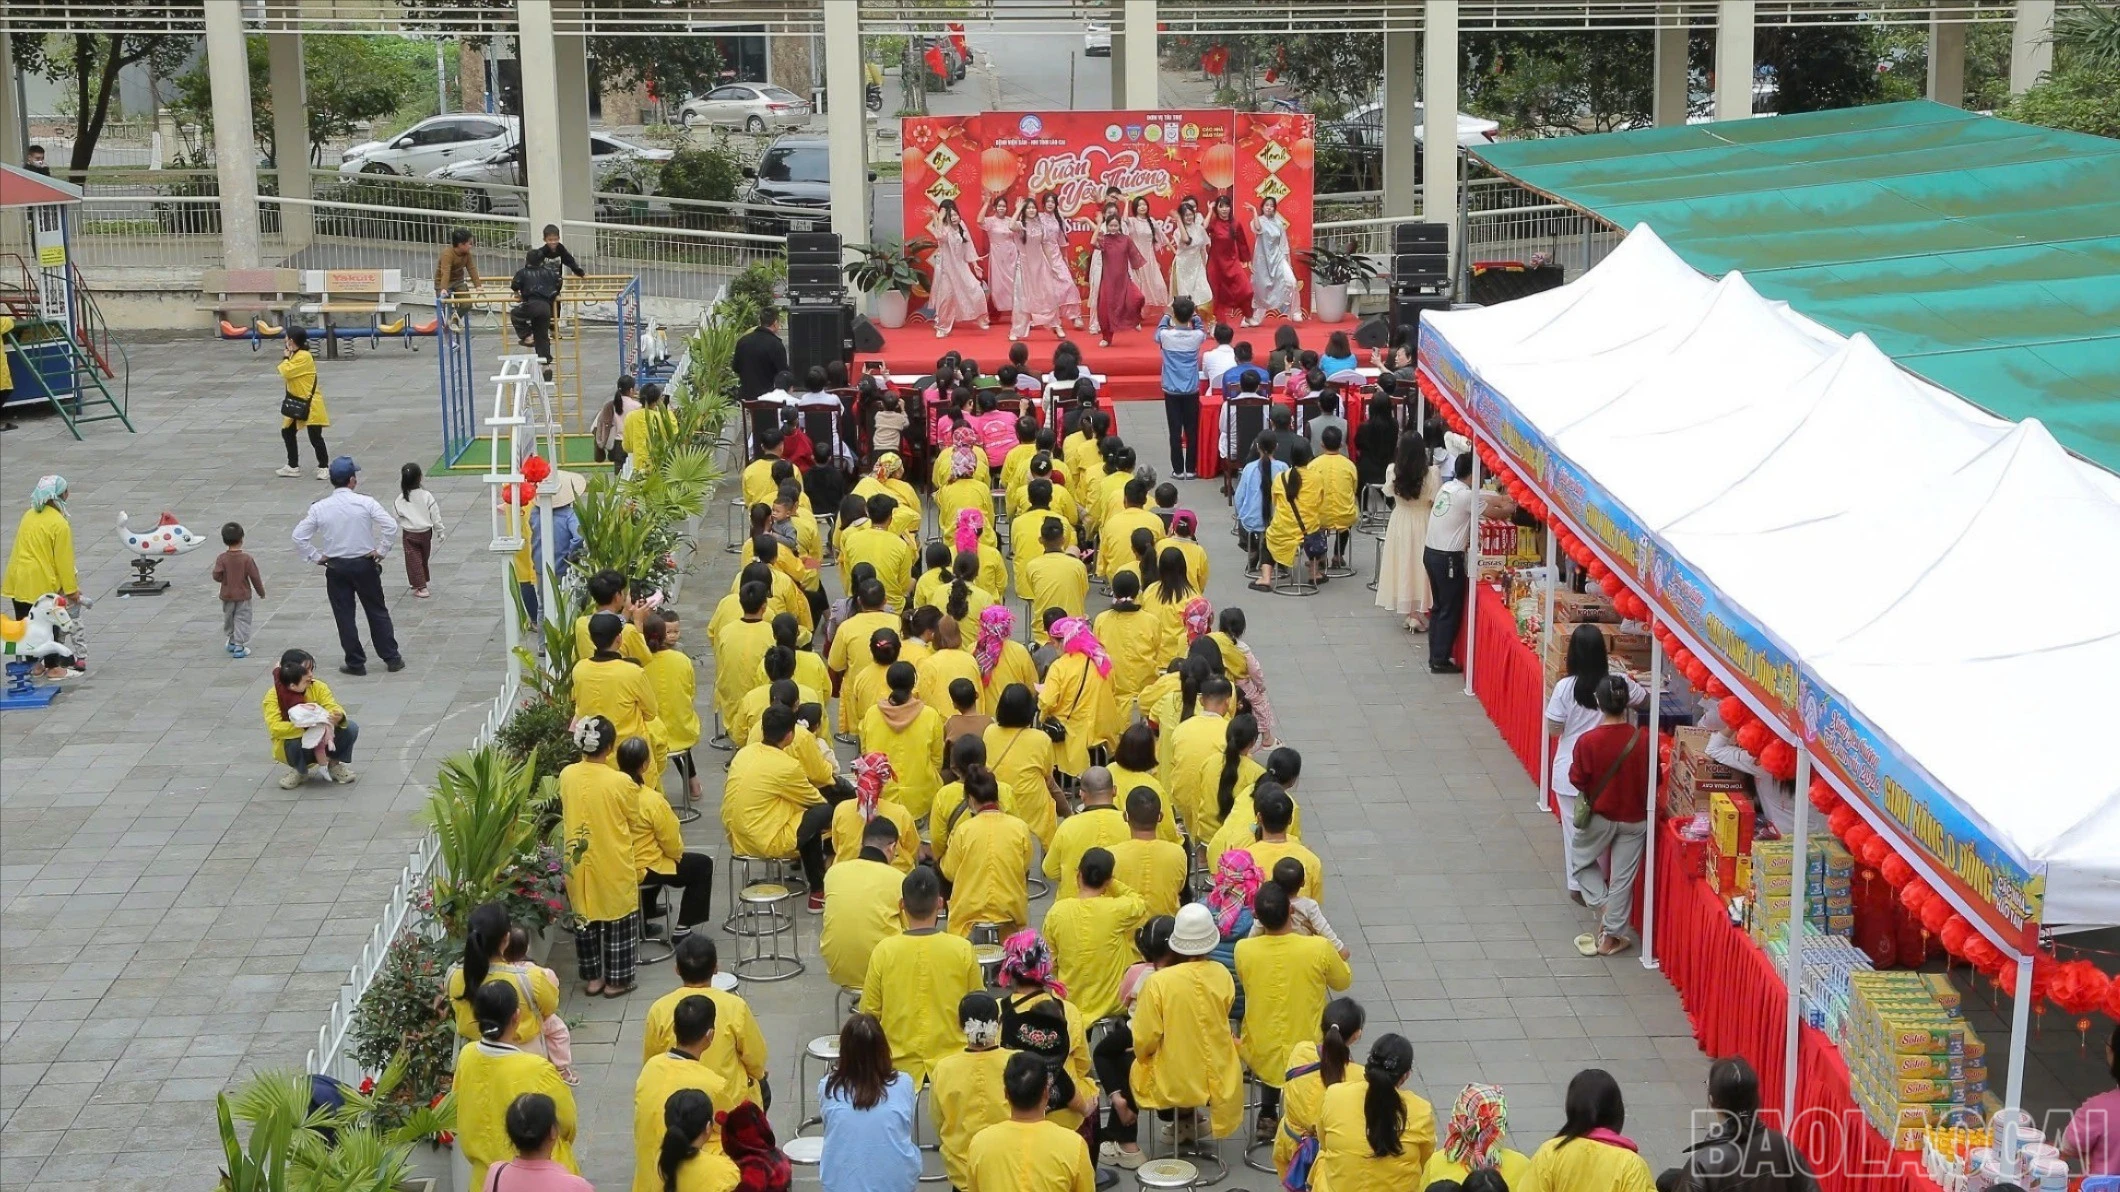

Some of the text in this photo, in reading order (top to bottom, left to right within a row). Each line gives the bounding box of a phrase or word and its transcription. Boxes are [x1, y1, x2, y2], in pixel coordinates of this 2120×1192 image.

[1030, 154, 1090, 190] Xuân
[1058, 166, 1169, 215] Yêu Thương
[332, 273, 376, 281] Yakult
[1576, 608, 1606, 617] KOKOMI
[1883, 774, 1911, 830] GIAN
[1912, 801, 1945, 860] HÀNG
[1958, 840, 1993, 904] ĐỒNG
[1997, 873, 2012, 899] CÁC
[1902, 1034, 1927, 1045] Solite
[1903, 1058, 1928, 1069] Solite
[1905, 1081, 1930, 1094] Solite
